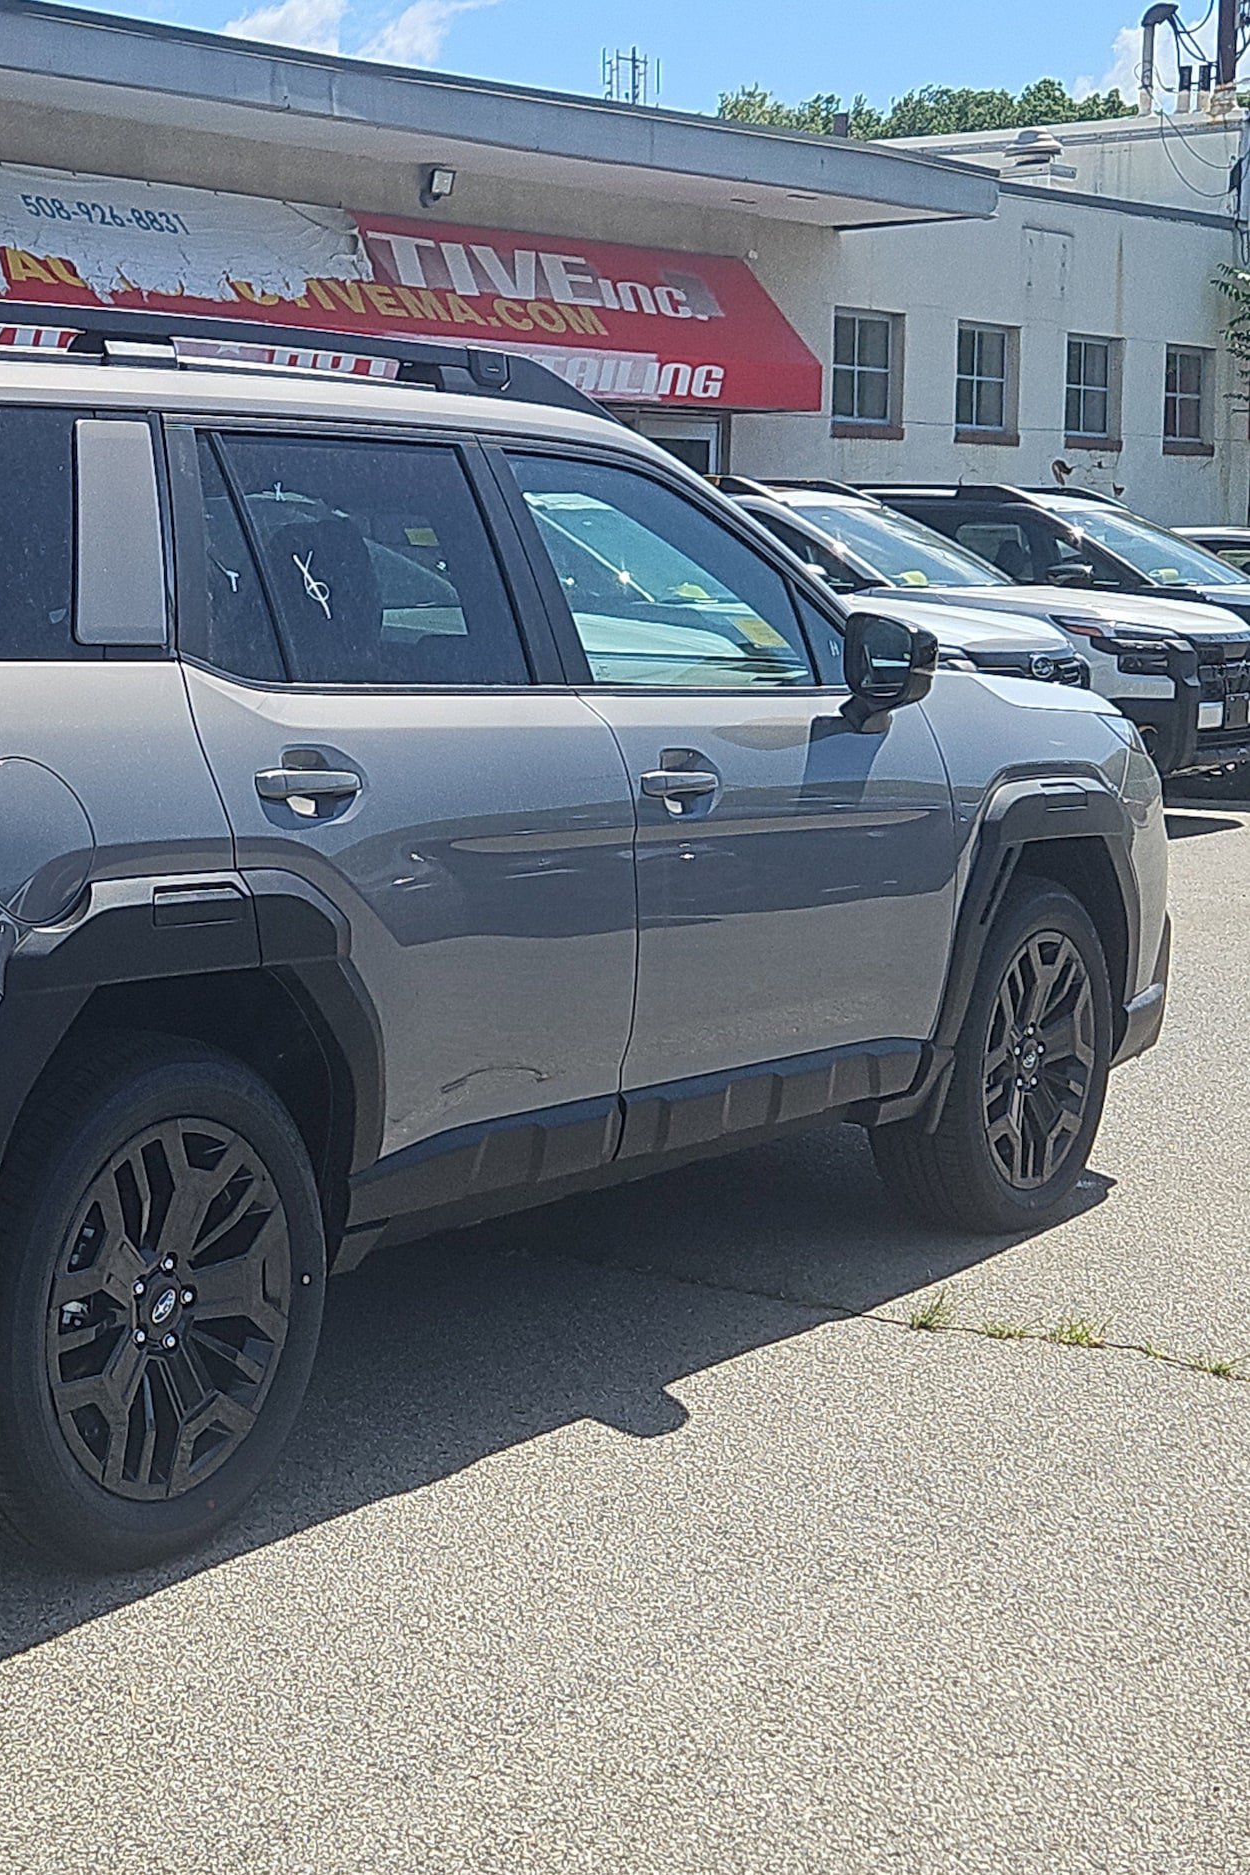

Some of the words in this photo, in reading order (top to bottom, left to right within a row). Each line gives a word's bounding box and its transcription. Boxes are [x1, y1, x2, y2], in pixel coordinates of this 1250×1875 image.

[20, 193, 191, 236] 508-926-8831
[366, 230, 601, 307] TIVE
[533, 354, 725, 399] TAILING
